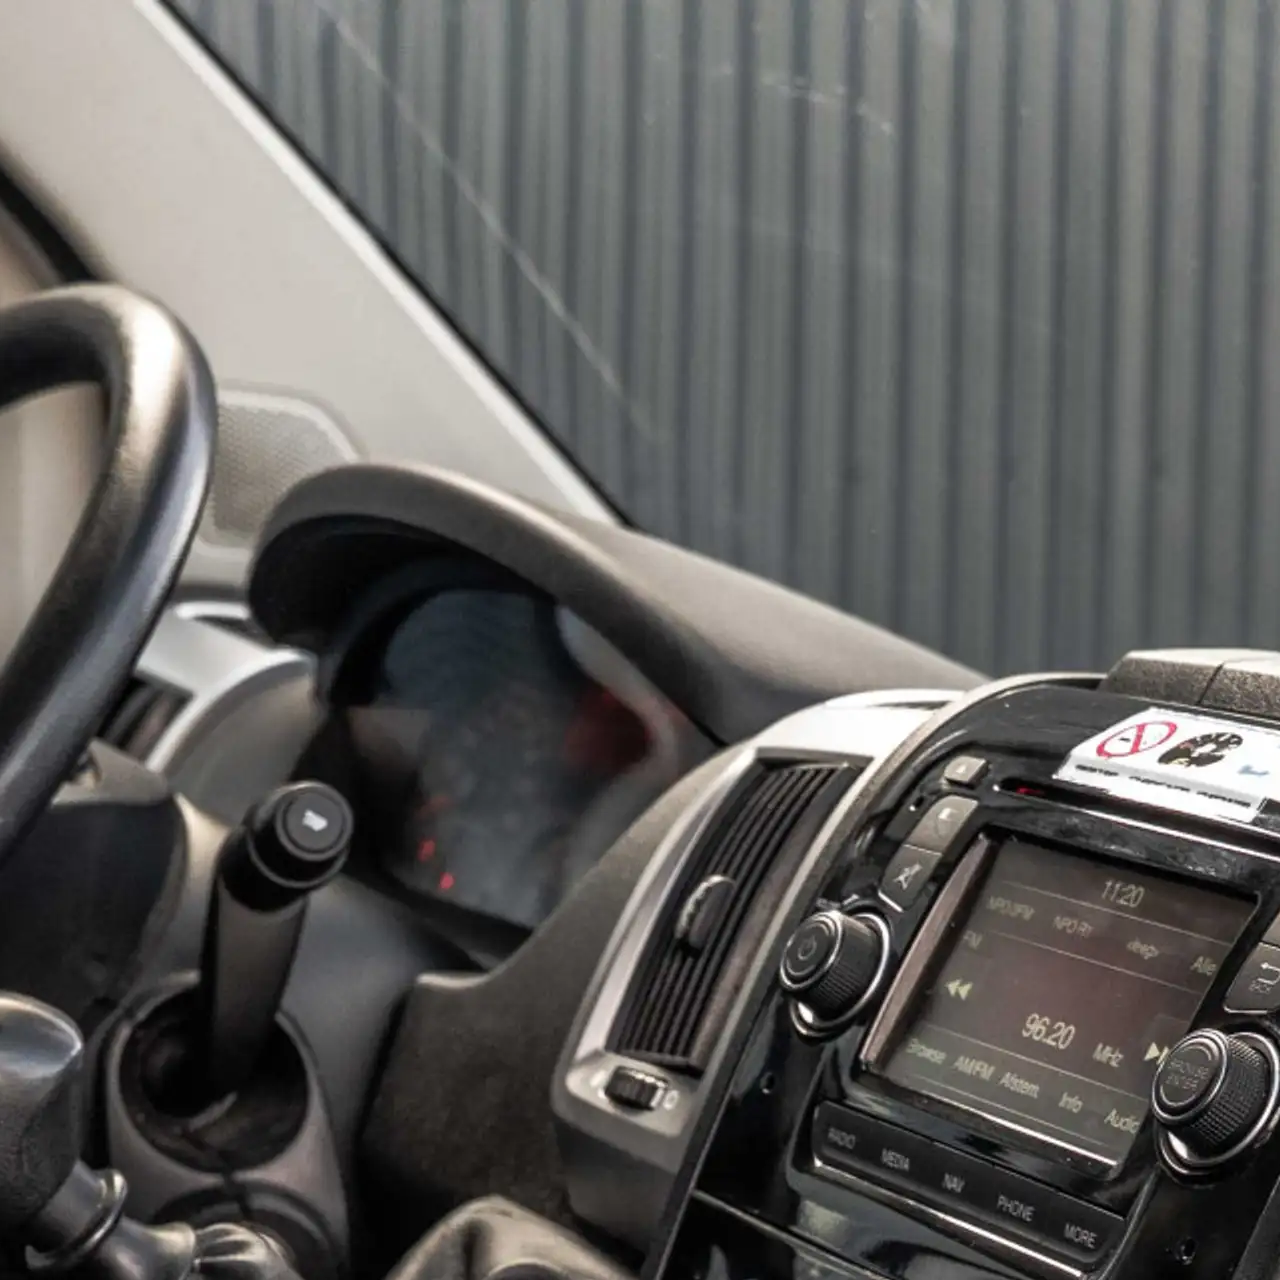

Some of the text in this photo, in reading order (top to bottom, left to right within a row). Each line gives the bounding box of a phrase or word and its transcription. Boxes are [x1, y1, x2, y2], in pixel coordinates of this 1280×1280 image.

[1021, 1012, 1124, 1068] 96.20 MHz
[1103, 1108, 1141, 1135] Audio
[881, 1148, 911, 1171] MEDIA
[942, 1172, 965, 1194] NAV
[997, 1194, 1037, 1222] PHONE
[1064, 1222, 1099, 1249] MORE
